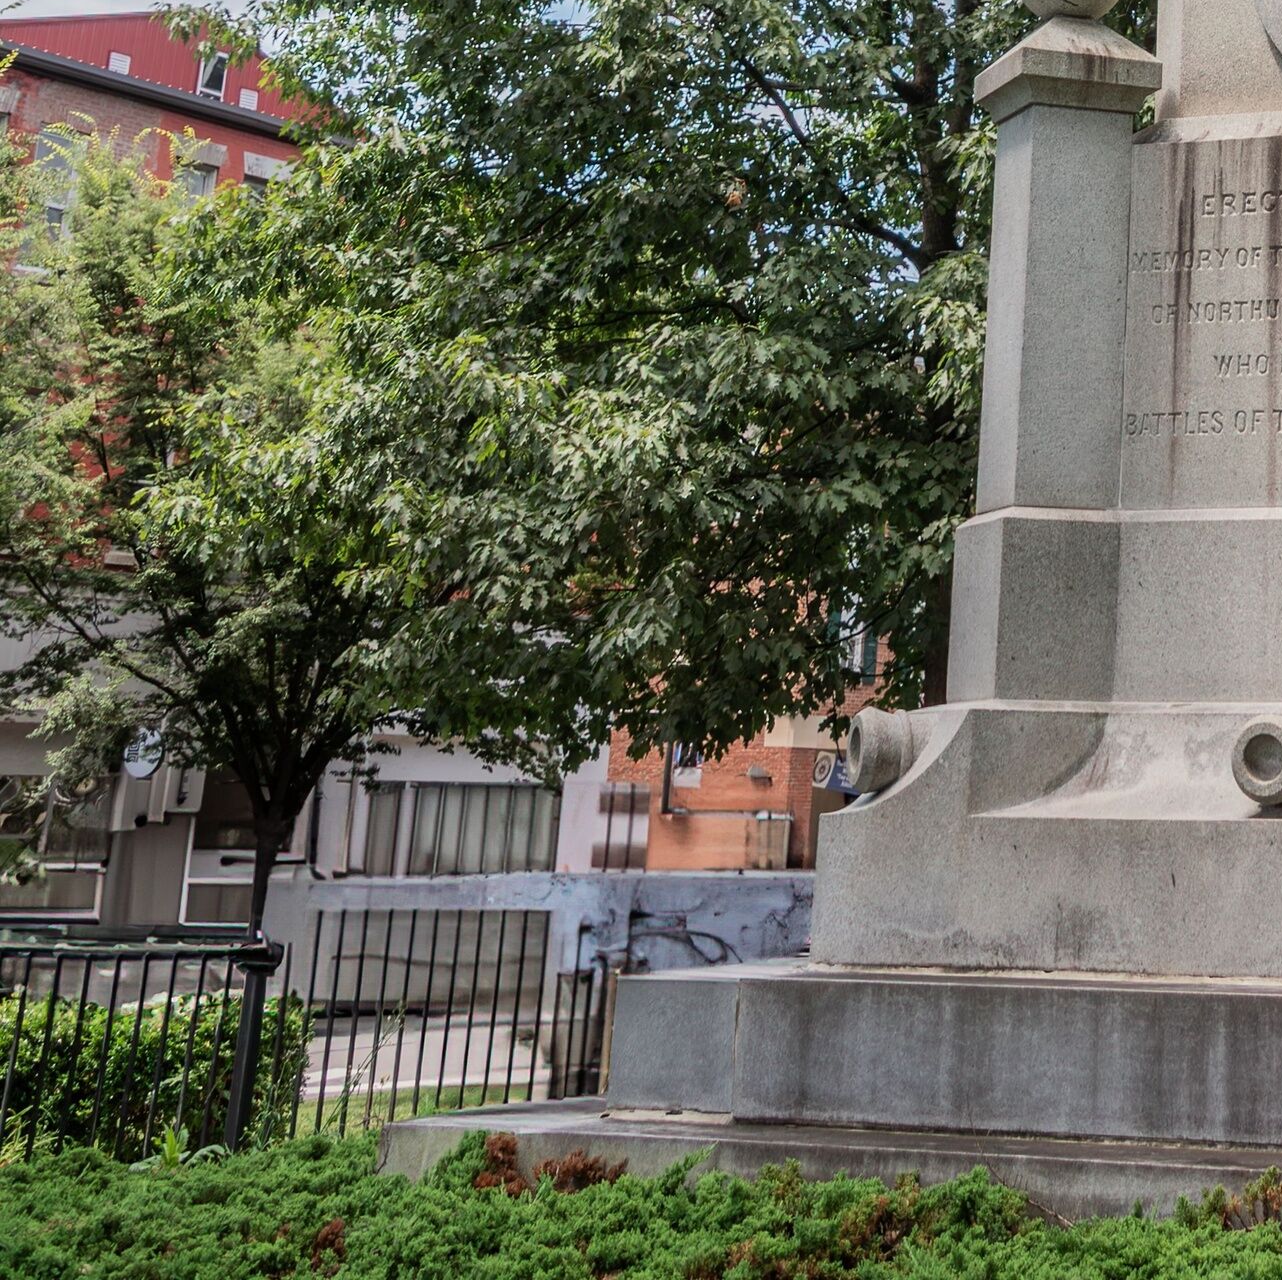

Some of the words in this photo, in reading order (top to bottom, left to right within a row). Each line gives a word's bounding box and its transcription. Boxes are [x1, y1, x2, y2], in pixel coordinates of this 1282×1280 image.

[1131, 247, 1230, 274] MEMORY
[1236, 247, 1262, 269] OF
[1151, 303, 1176, 326] OF
[1213, 353, 1270, 377] WHO
[1126, 409, 1225, 437] BATTLES
[1233, 410, 1261, 434] OF
